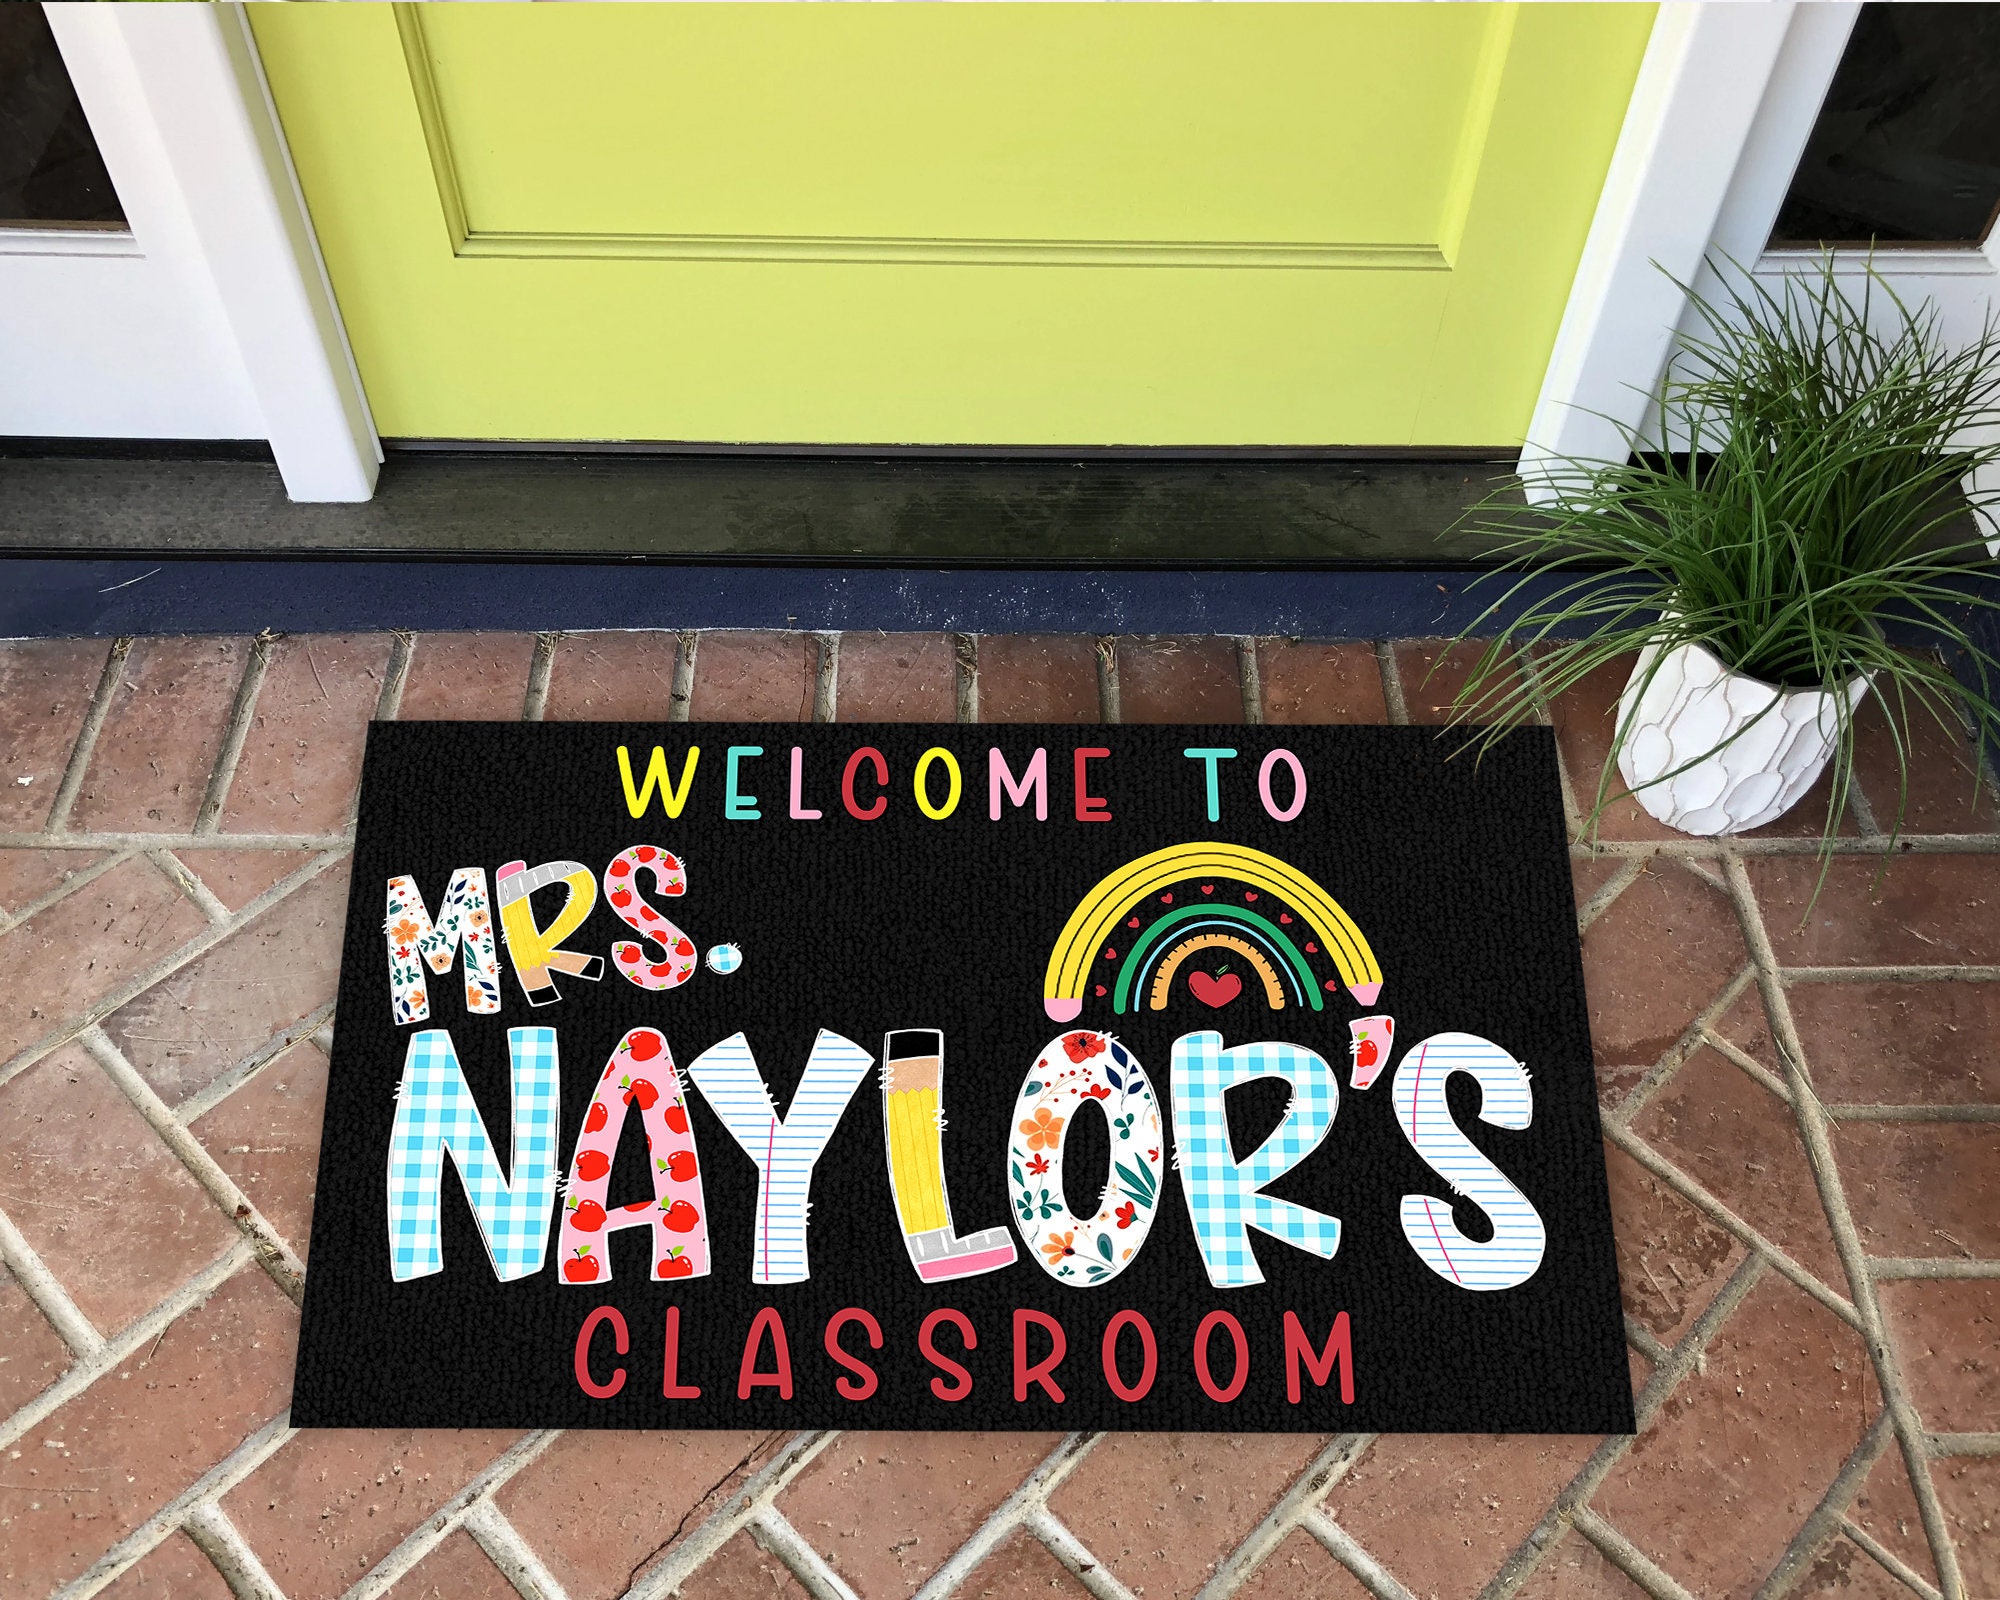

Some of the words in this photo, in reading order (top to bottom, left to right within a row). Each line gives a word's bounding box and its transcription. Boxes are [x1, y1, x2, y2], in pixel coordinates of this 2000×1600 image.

[616, 745, 1113, 822] WELCOME
[1183, 747, 1308, 823] TO
[382, 844, 743, 1026] MRS.
[386, 1014, 1547, 1292] NAYLOR'S
[574, 1305, 1355, 1405] CLASSROOM
